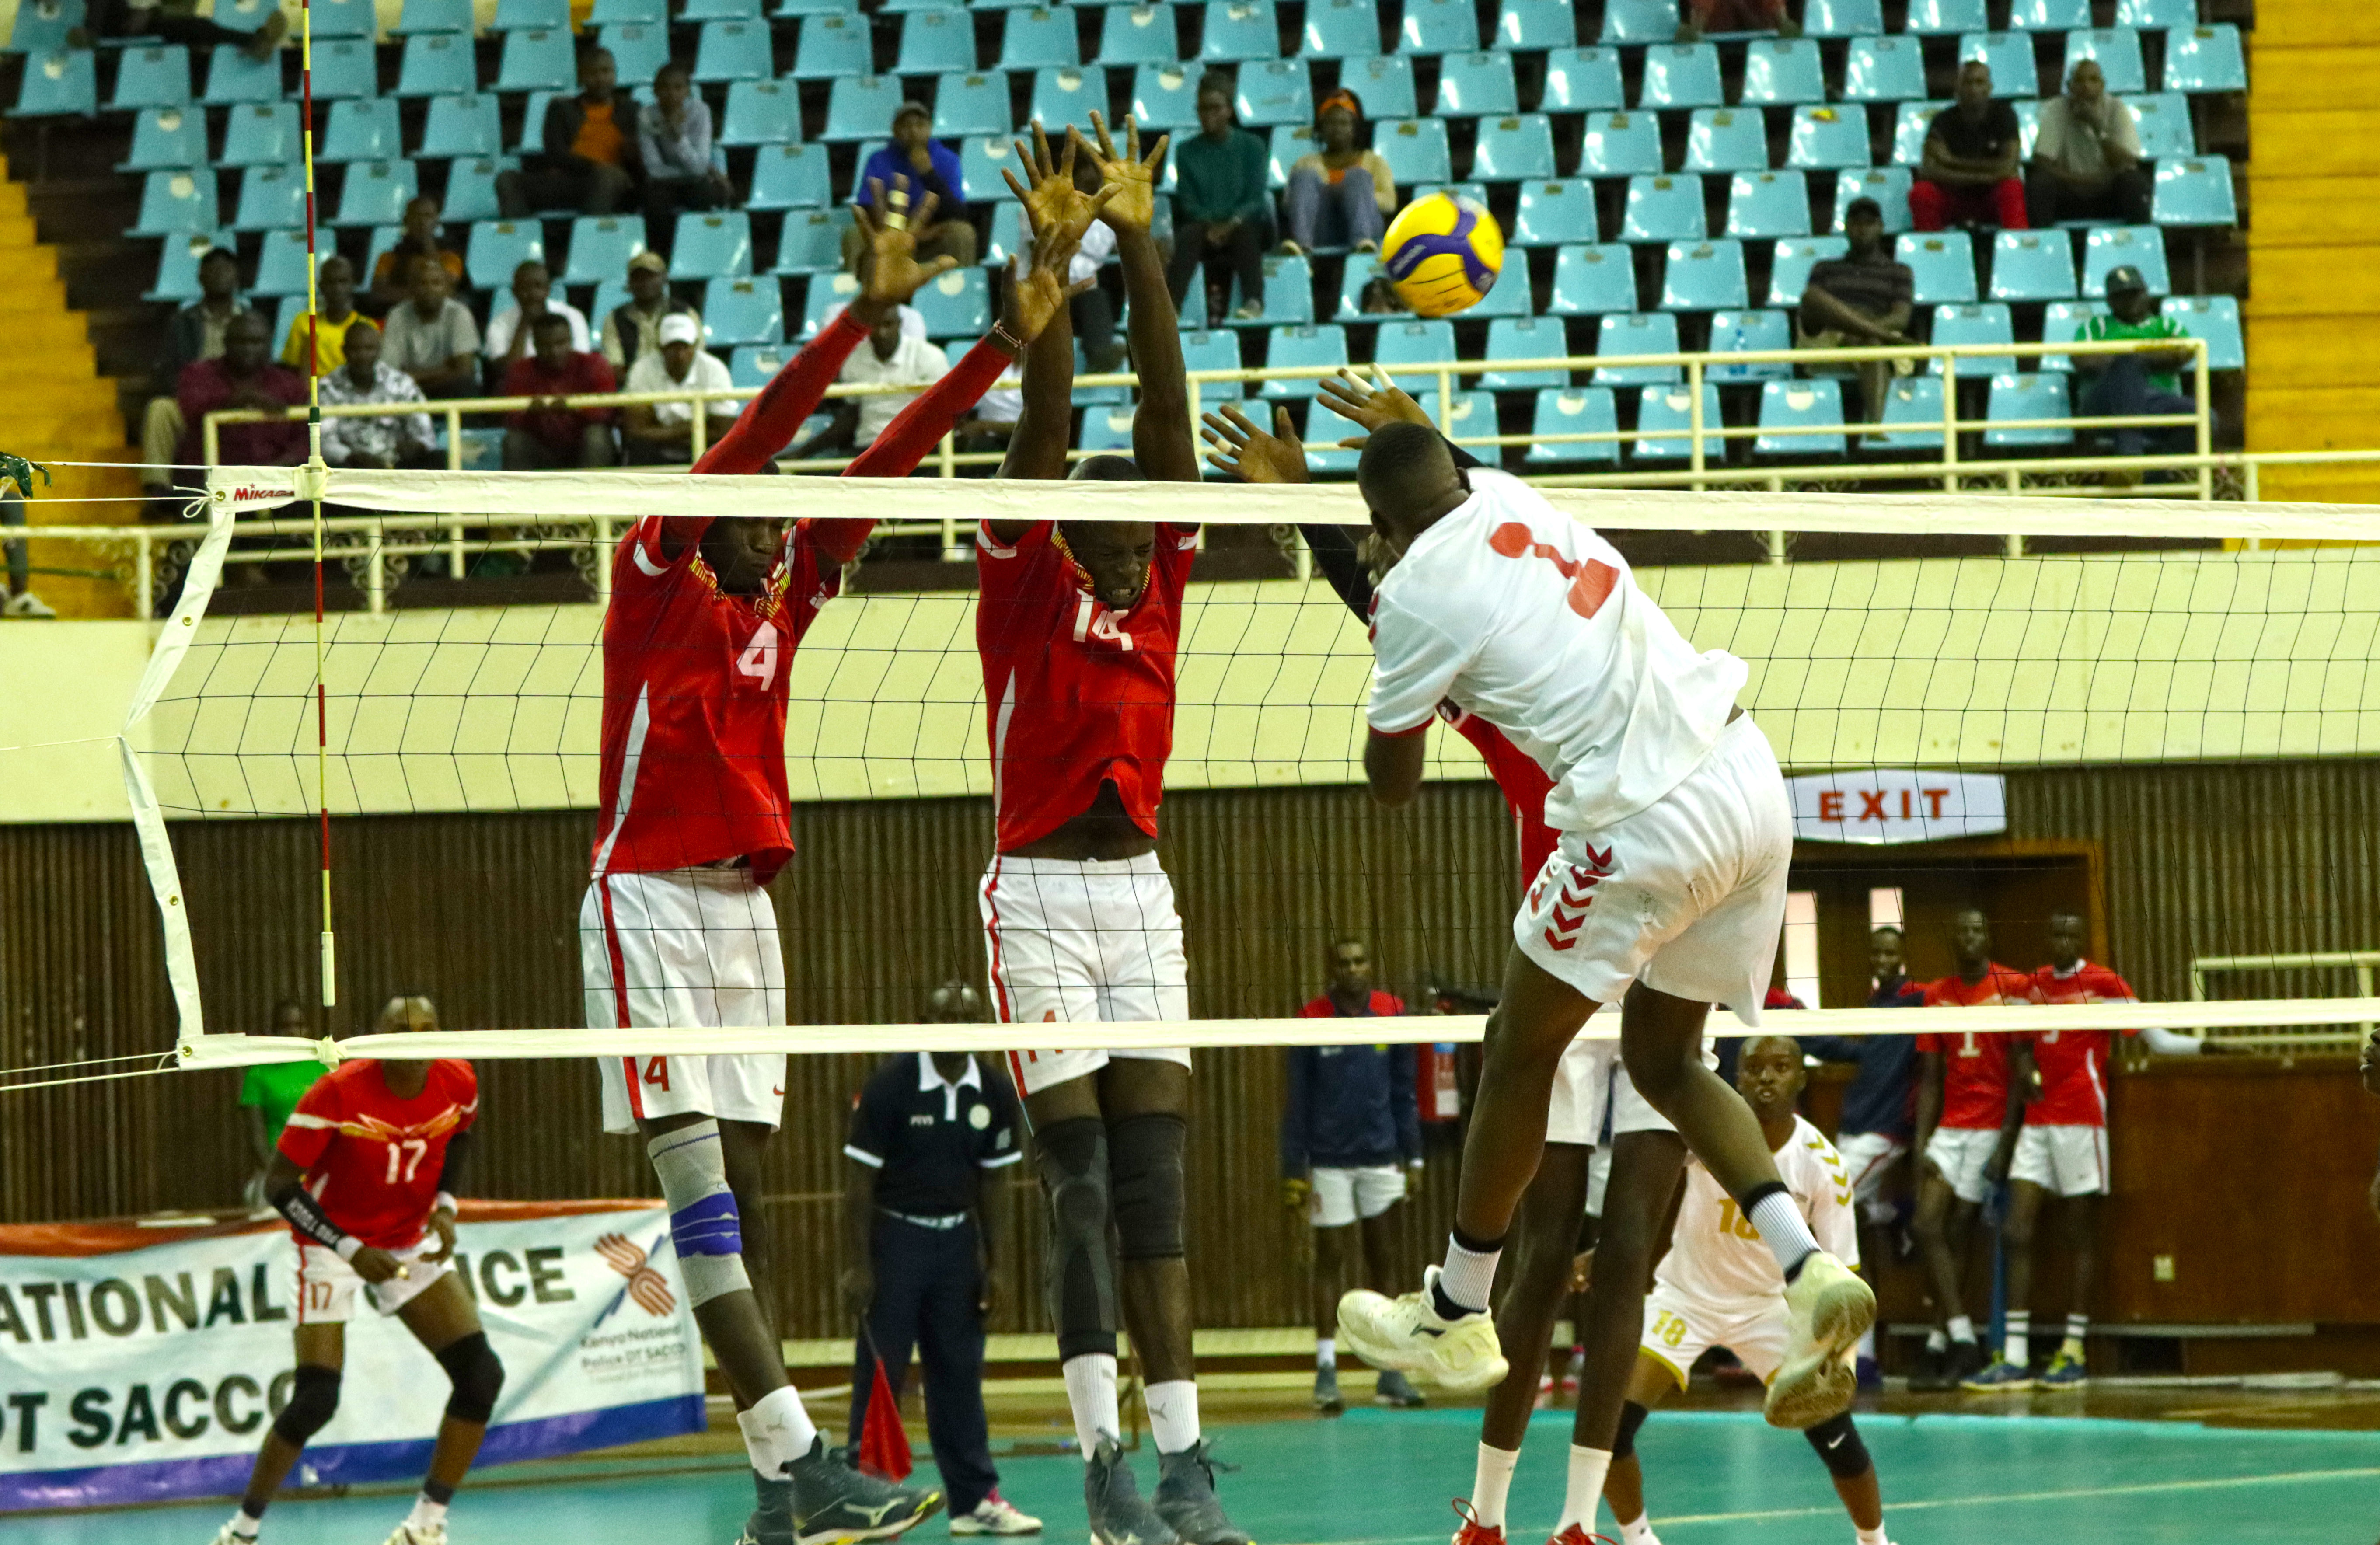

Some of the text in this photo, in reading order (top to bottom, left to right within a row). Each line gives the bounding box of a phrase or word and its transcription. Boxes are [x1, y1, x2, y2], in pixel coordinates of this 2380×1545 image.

[1073, 587, 1134, 651] 14
[736, 620, 778, 691] 4
[1819, 787, 1950, 822] EXIT
[644, 1055, 670, 1092] 4
[385, 1139, 427, 1184] 17
[311, 1282, 333, 1310] 17
[1651, 1309, 1687, 1346] 18
